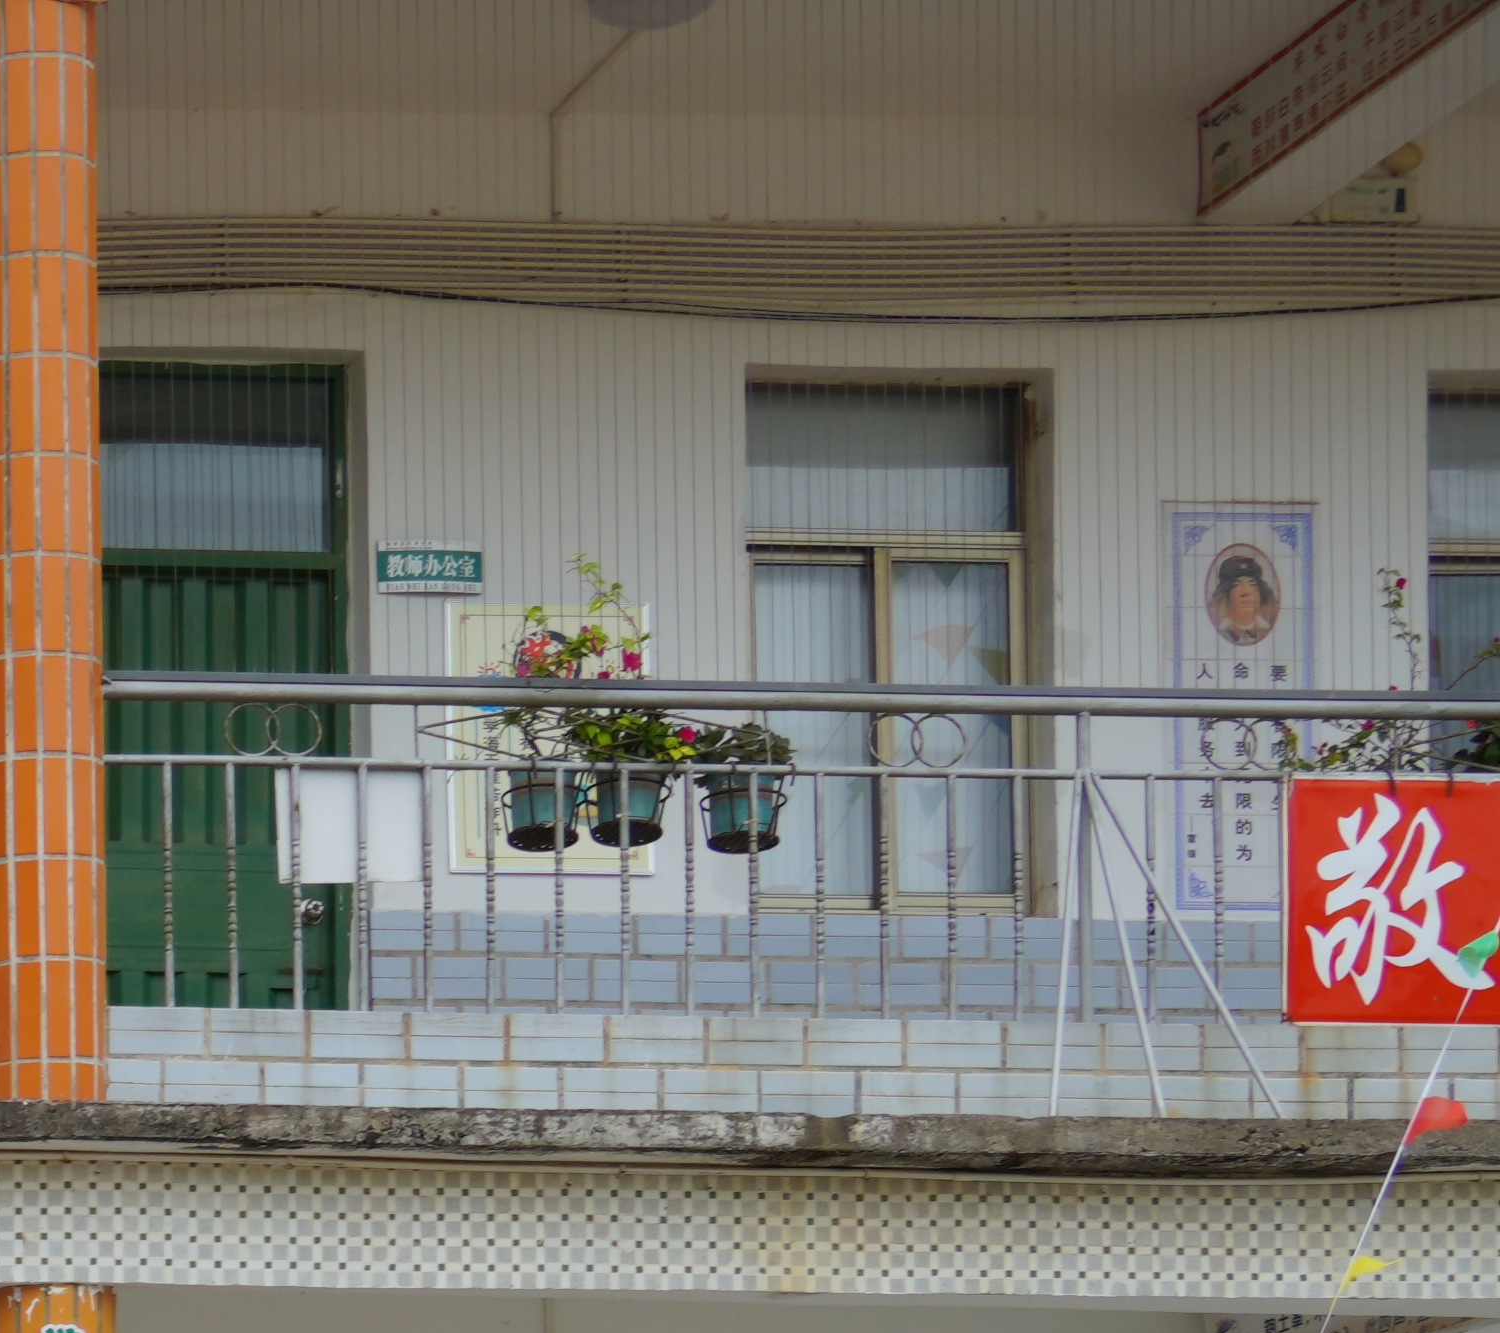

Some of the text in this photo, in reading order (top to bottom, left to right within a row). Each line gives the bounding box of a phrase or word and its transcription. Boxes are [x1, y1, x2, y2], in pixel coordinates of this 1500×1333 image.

[386, 553, 476, 578] 教师办公室
[1303, 792, 1498, 1007] 敬
